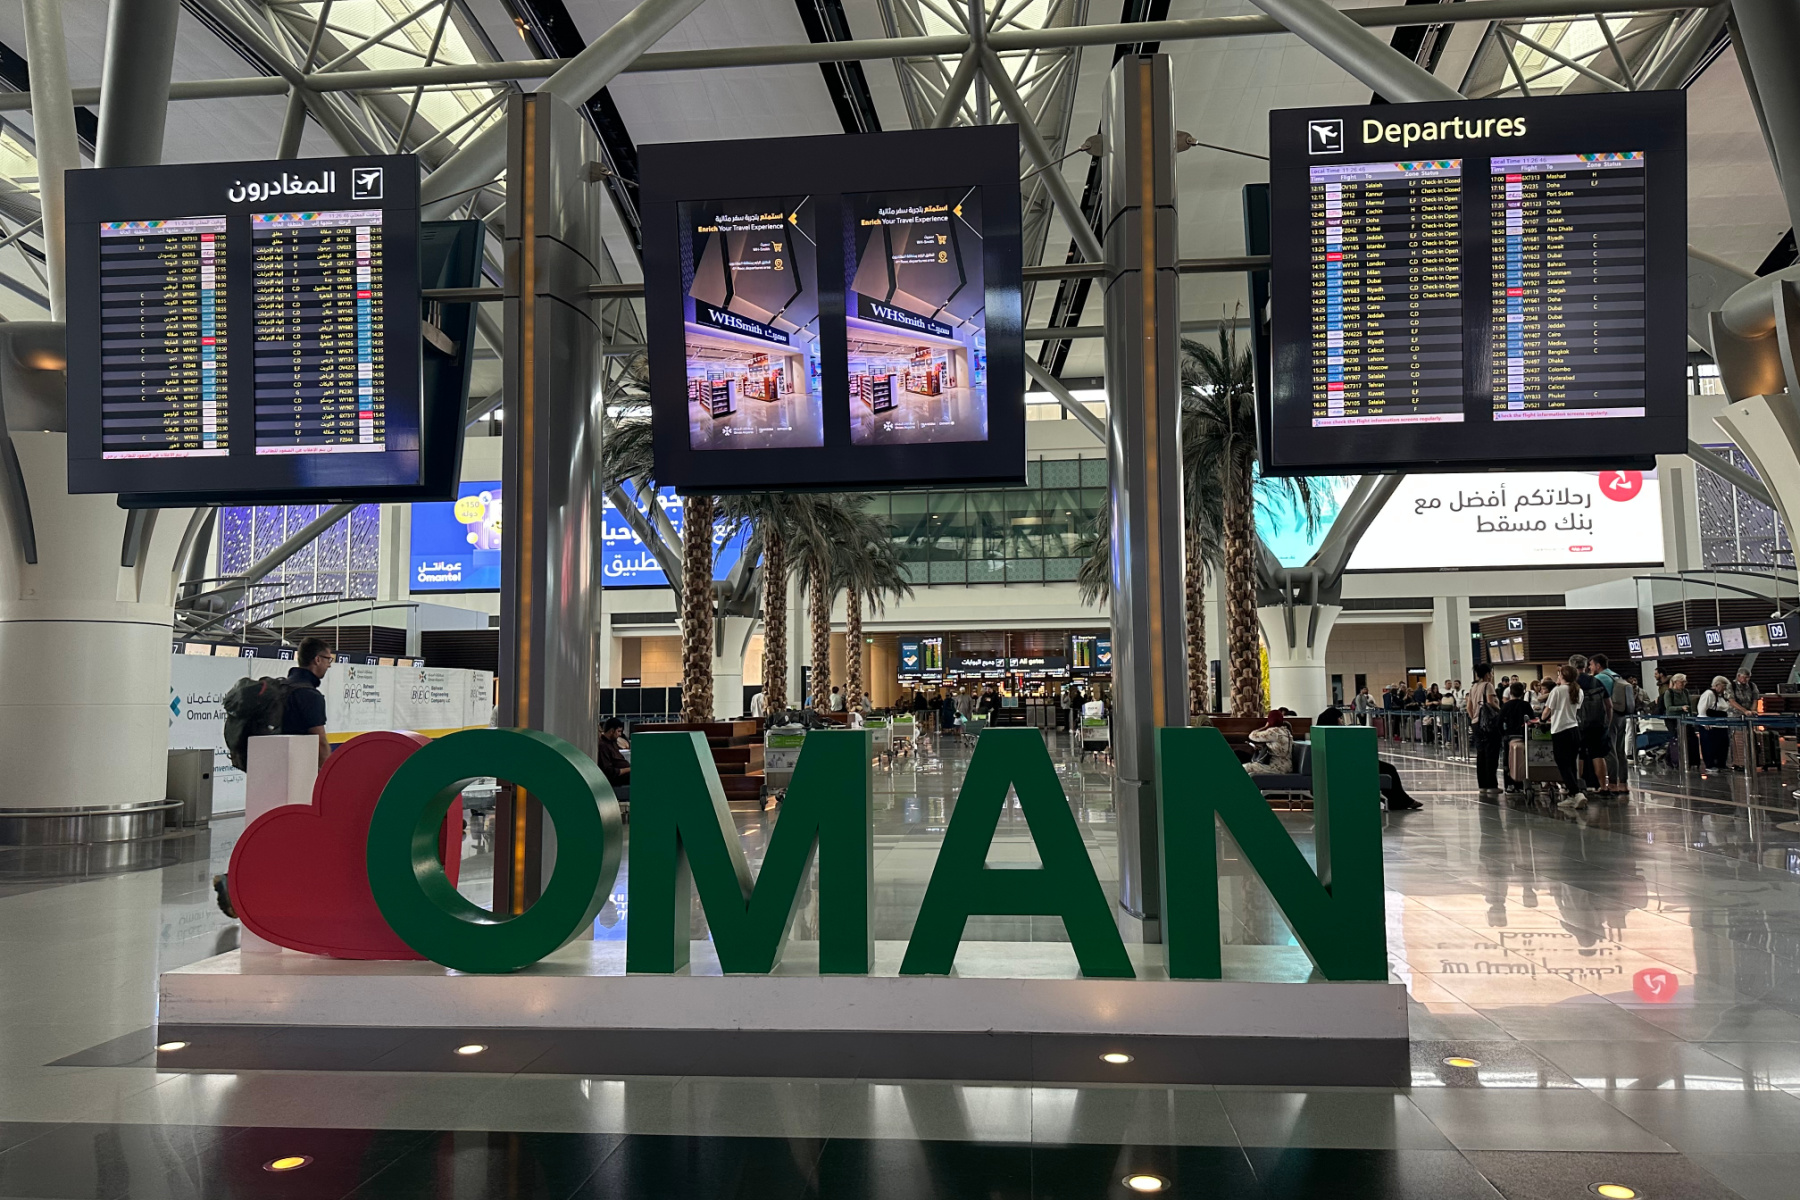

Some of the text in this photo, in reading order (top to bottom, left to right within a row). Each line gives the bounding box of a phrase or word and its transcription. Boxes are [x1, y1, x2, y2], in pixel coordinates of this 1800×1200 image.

[1362, 115, 1526, 148] Departures
[228, 172, 336, 204] المغادرون
[924, 205, 948, 213] استمتع
[760, 213, 783, 221] استمتع
[915, 216, 948, 224] Experience
[870, 303, 925, 328] WHSmith
[928, 323, 950, 335] سميث
[708, 308, 762, 334] WHSmith
[765, 329, 787, 341] سميث
[1414, 482, 1591, 514] رحلاتكم أفضل مع
[1477, 512, 1593, 535] بنك مسقط
[418, 561, 461, 572] عمانتل
[418, 572, 461, 582] Omantel
[1772, 625, 1783, 637] D9
[1678, 636, 1690, 646] D11
[1707, 633, 1720, 643] D10
[1630, 641, 1640, 651] D12
[244, 649, 254, 658] F8
[344, 688, 361, 699] BEC
[411, 690, 429, 700] BEC
[187, 710, 212, 720] Oman
[366, 725, 1387, 980] OMAN
